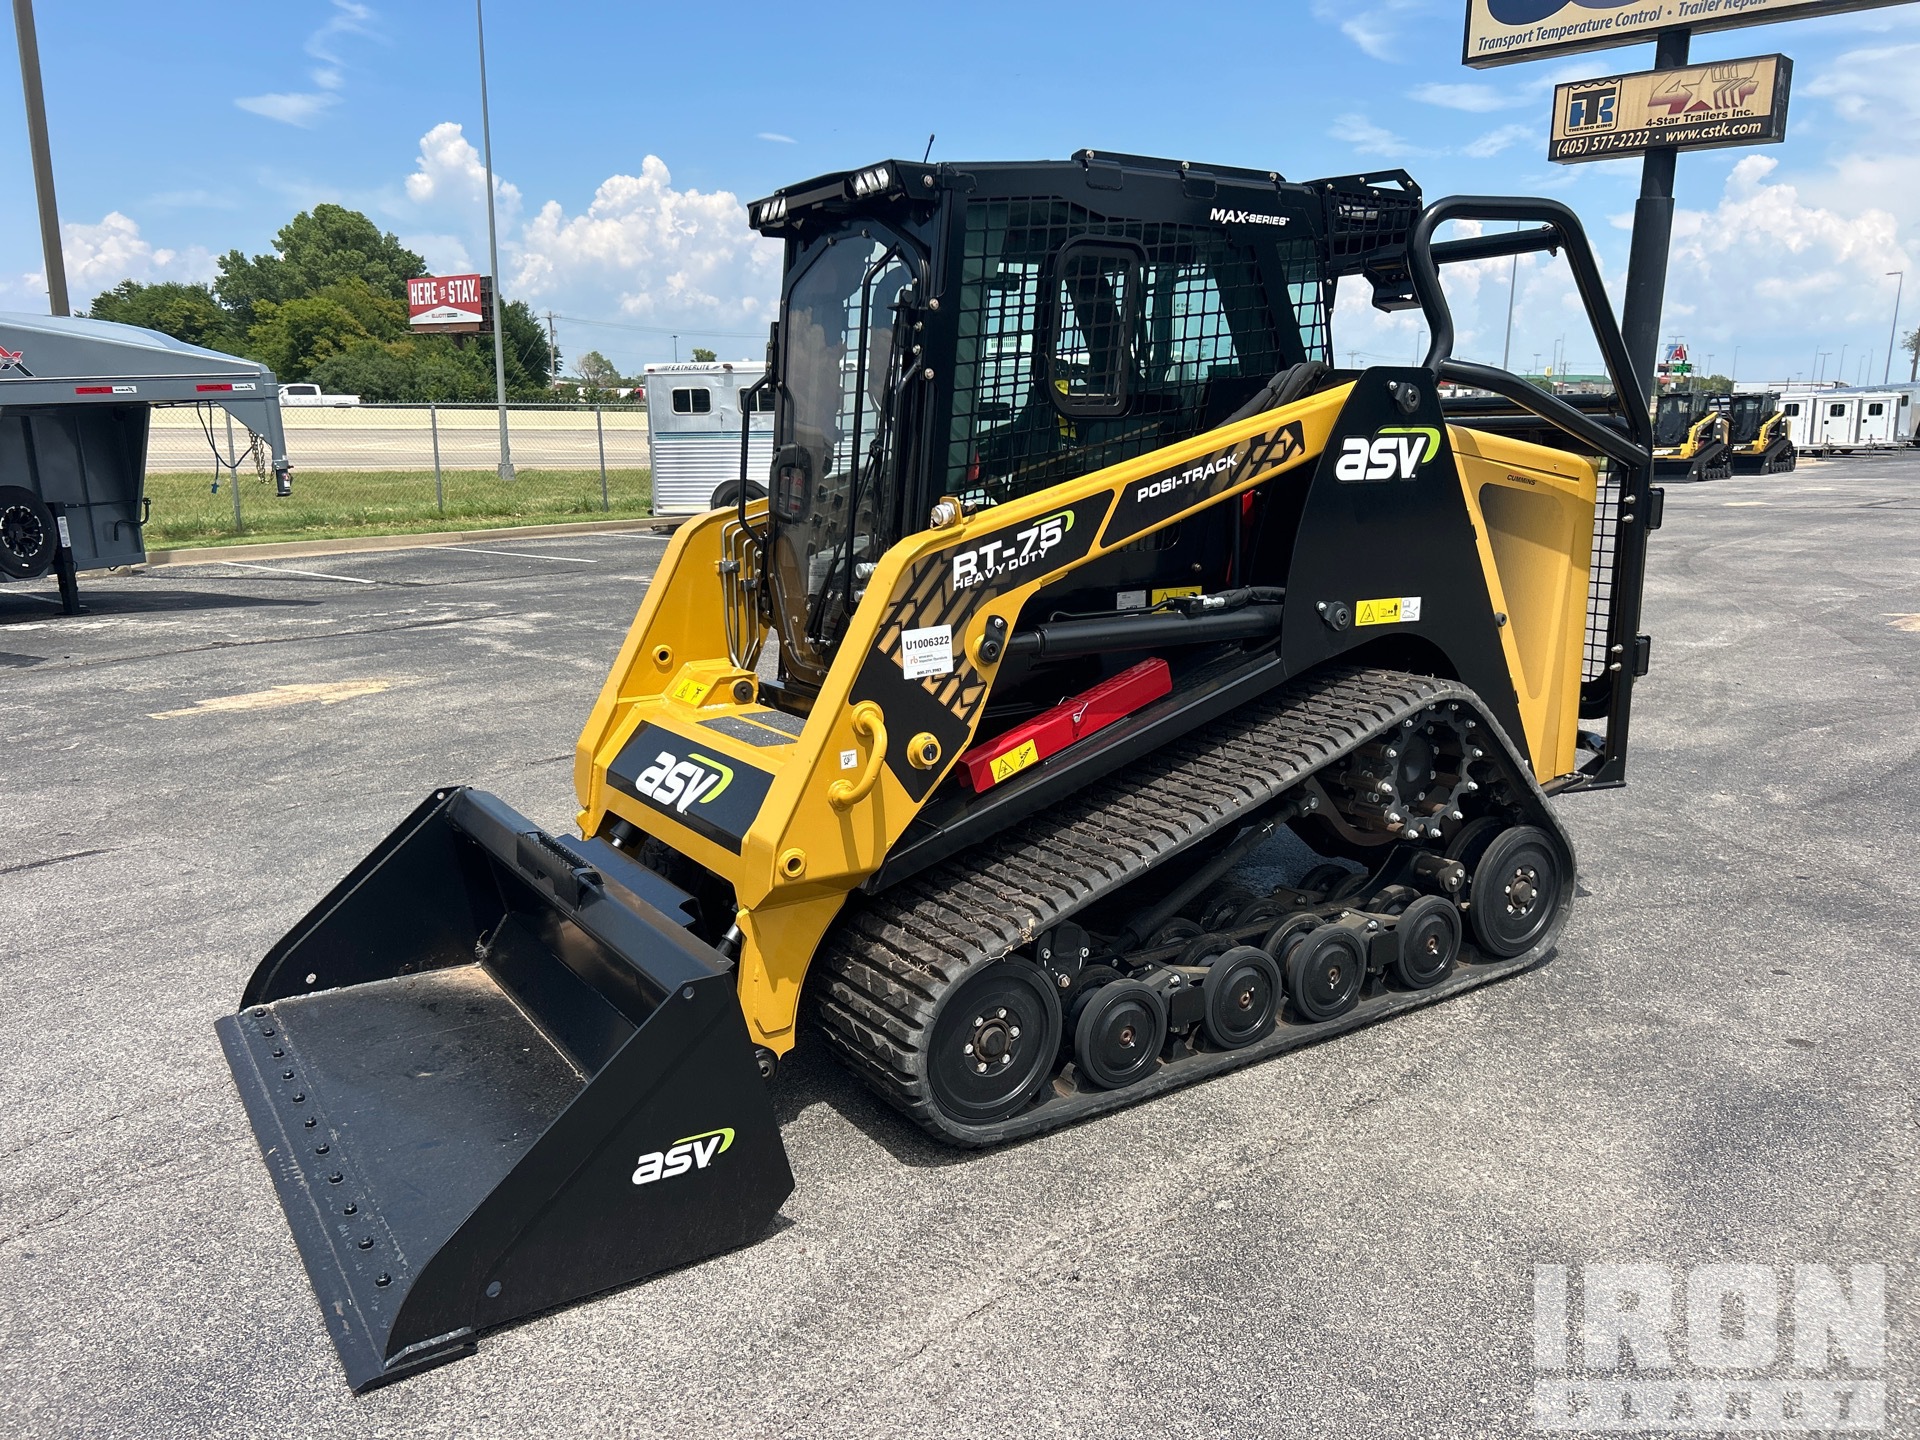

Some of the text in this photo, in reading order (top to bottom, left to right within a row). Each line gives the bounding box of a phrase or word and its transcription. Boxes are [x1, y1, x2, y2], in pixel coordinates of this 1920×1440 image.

[1478, 29, 1534, 51] Transport
[1536, 18, 1612, 41] Temperature
[1615, 5, 1663, 27] Control
[1678, 0, 1721, 17] Trailer
[1568, 125, 1594, 133] THERMO
[1645, 108, 1755, 127] 4-Star Trailers Inc.
[1556, 122, 1762, 158] (405) 577-2222 www.cstk.com
[411, 282, 439, 306] HERE
[448, 279, 479, 304] STAY.
[666, 364, 710, 372] FEATHERLITE
[1137, 453, 1237, 503] POSI-TRACK
[1506, 474, 1537, 486] CUMMINS
[953, 518, 1062, 583] RT-75
[953, 546, 1048, 592] HEAVY DUTY
[905, 635, 950, 650] U1006322
